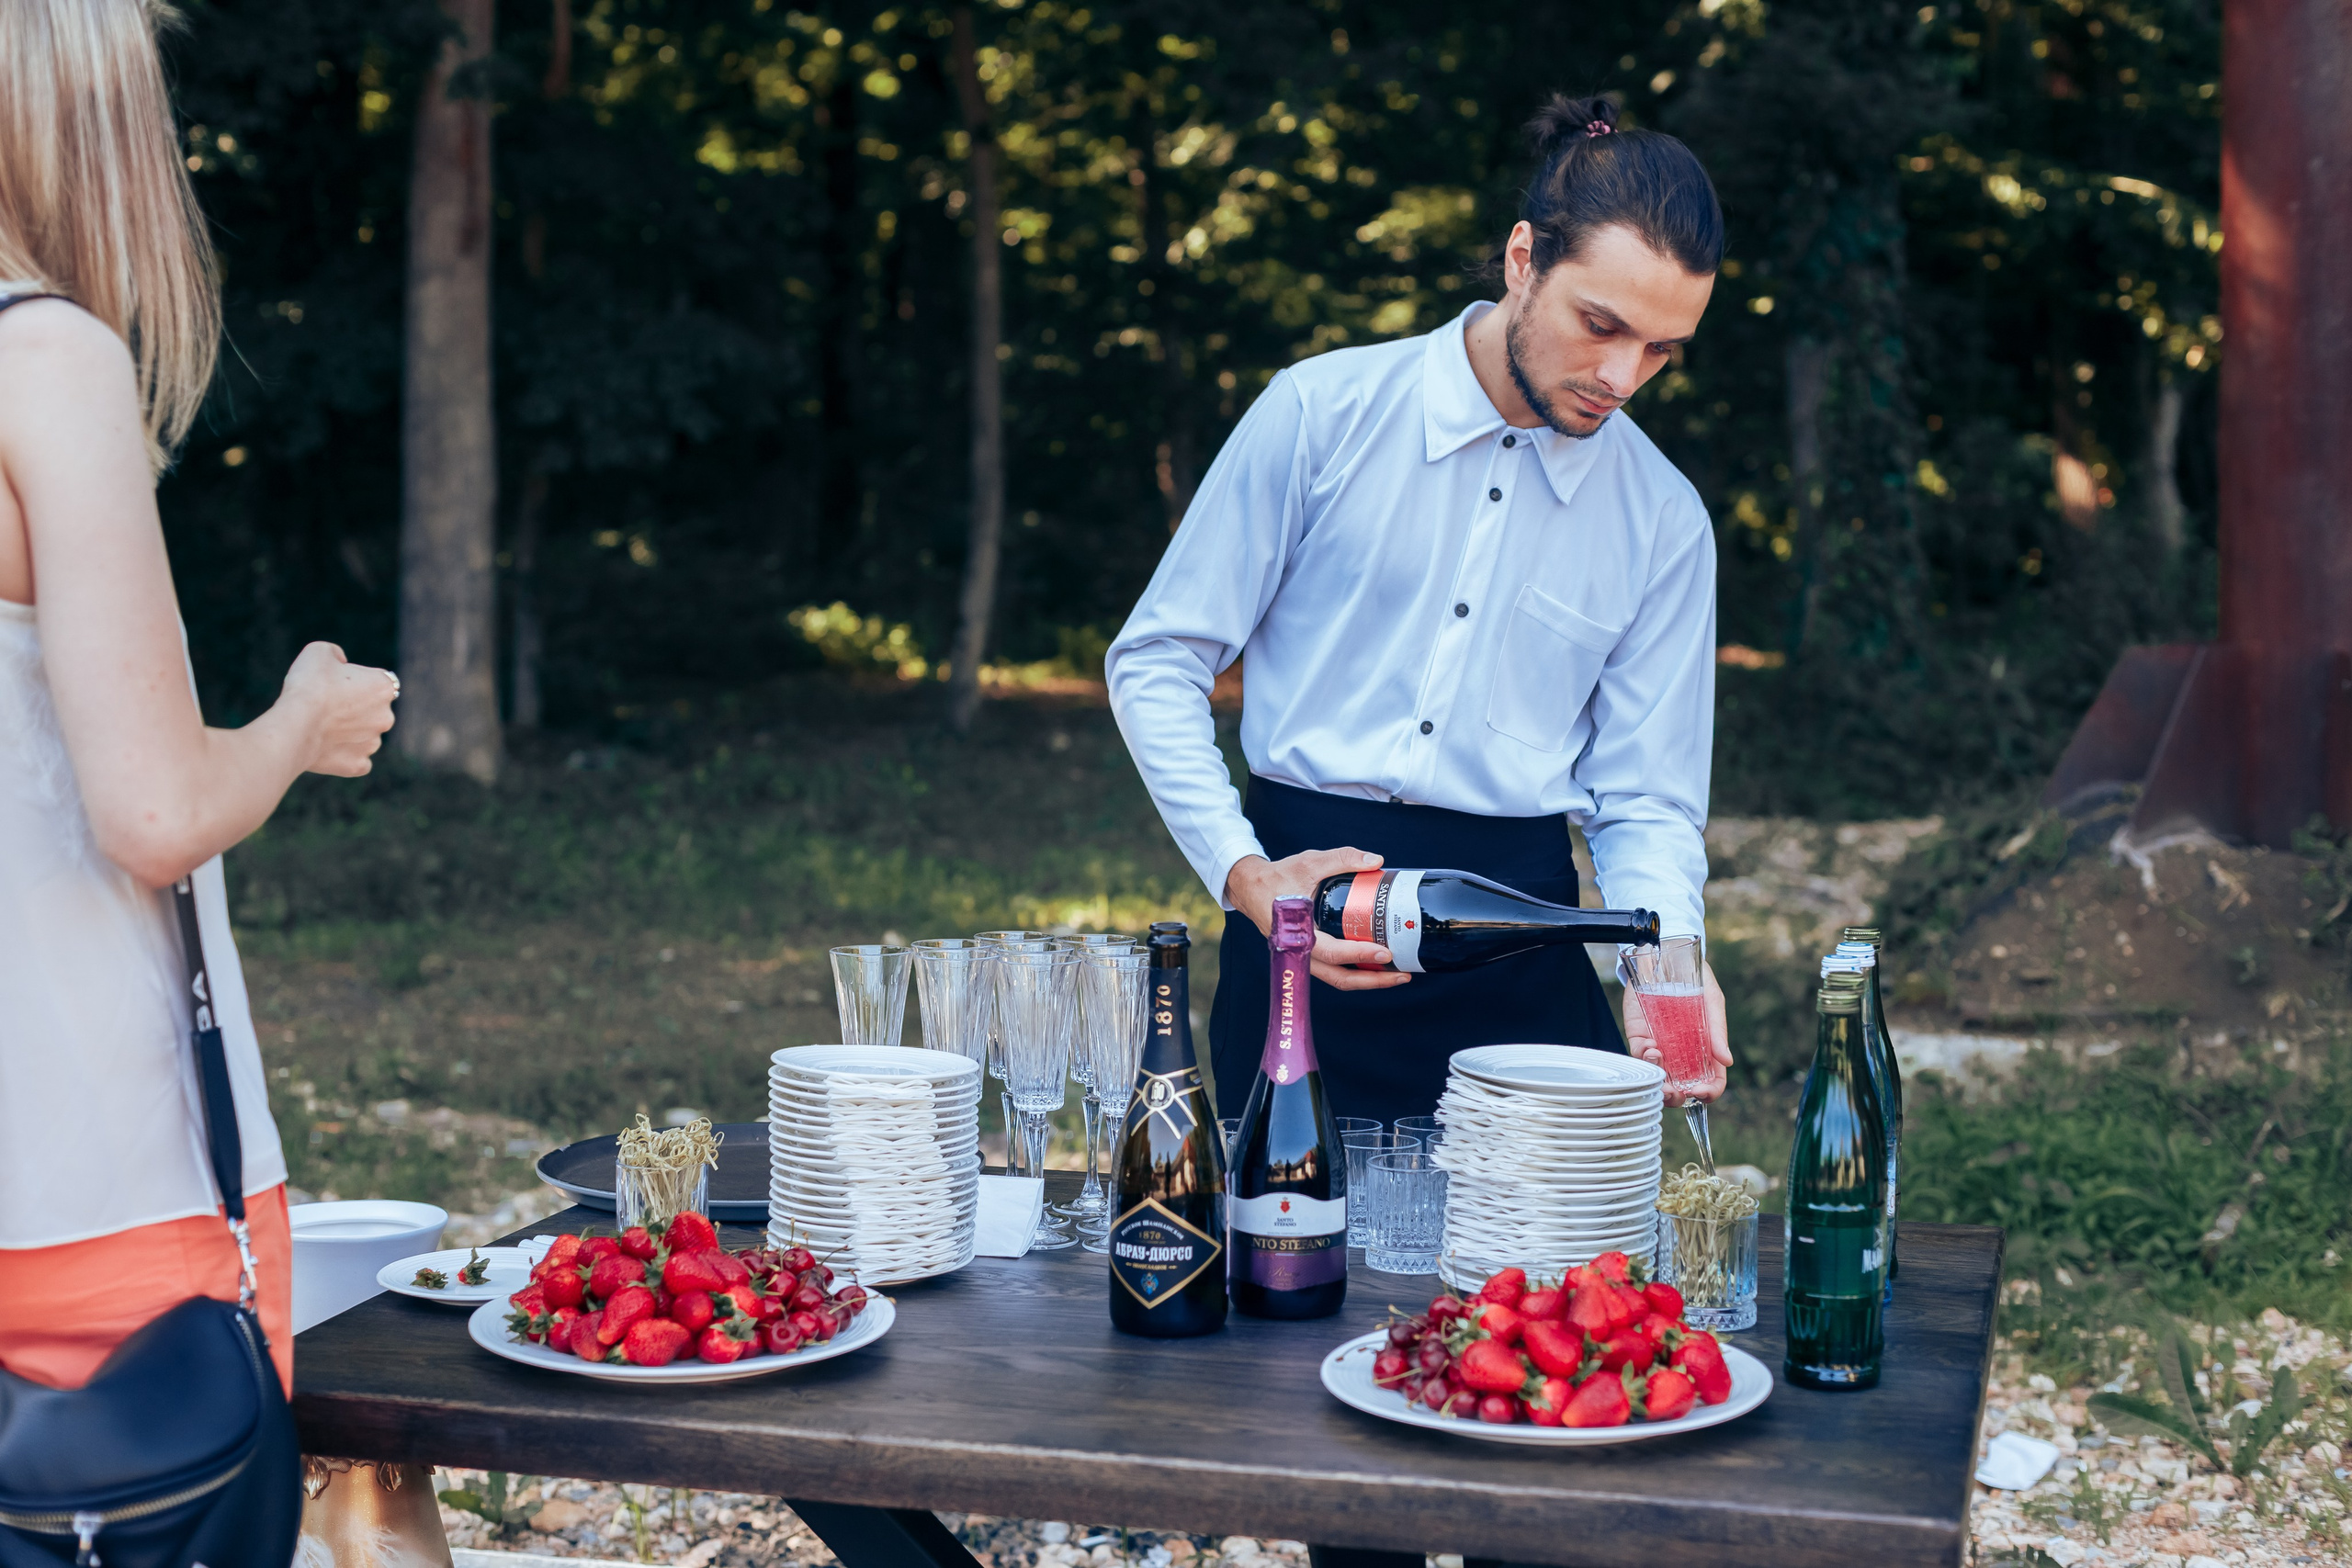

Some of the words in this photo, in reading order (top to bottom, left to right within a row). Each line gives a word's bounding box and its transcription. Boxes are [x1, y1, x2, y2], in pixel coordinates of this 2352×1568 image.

[1375, 883, 1389, 917] SANTO
[1155, 985, 1173, 1036] 1870
[1281, 969, 1295, 1036] STEFANO
[1280, 1038, 1292, 1050] S.
[1252, 1237, 1277, 1250] NTO
[1279, 1237, 1330, 1250] STEFANO
